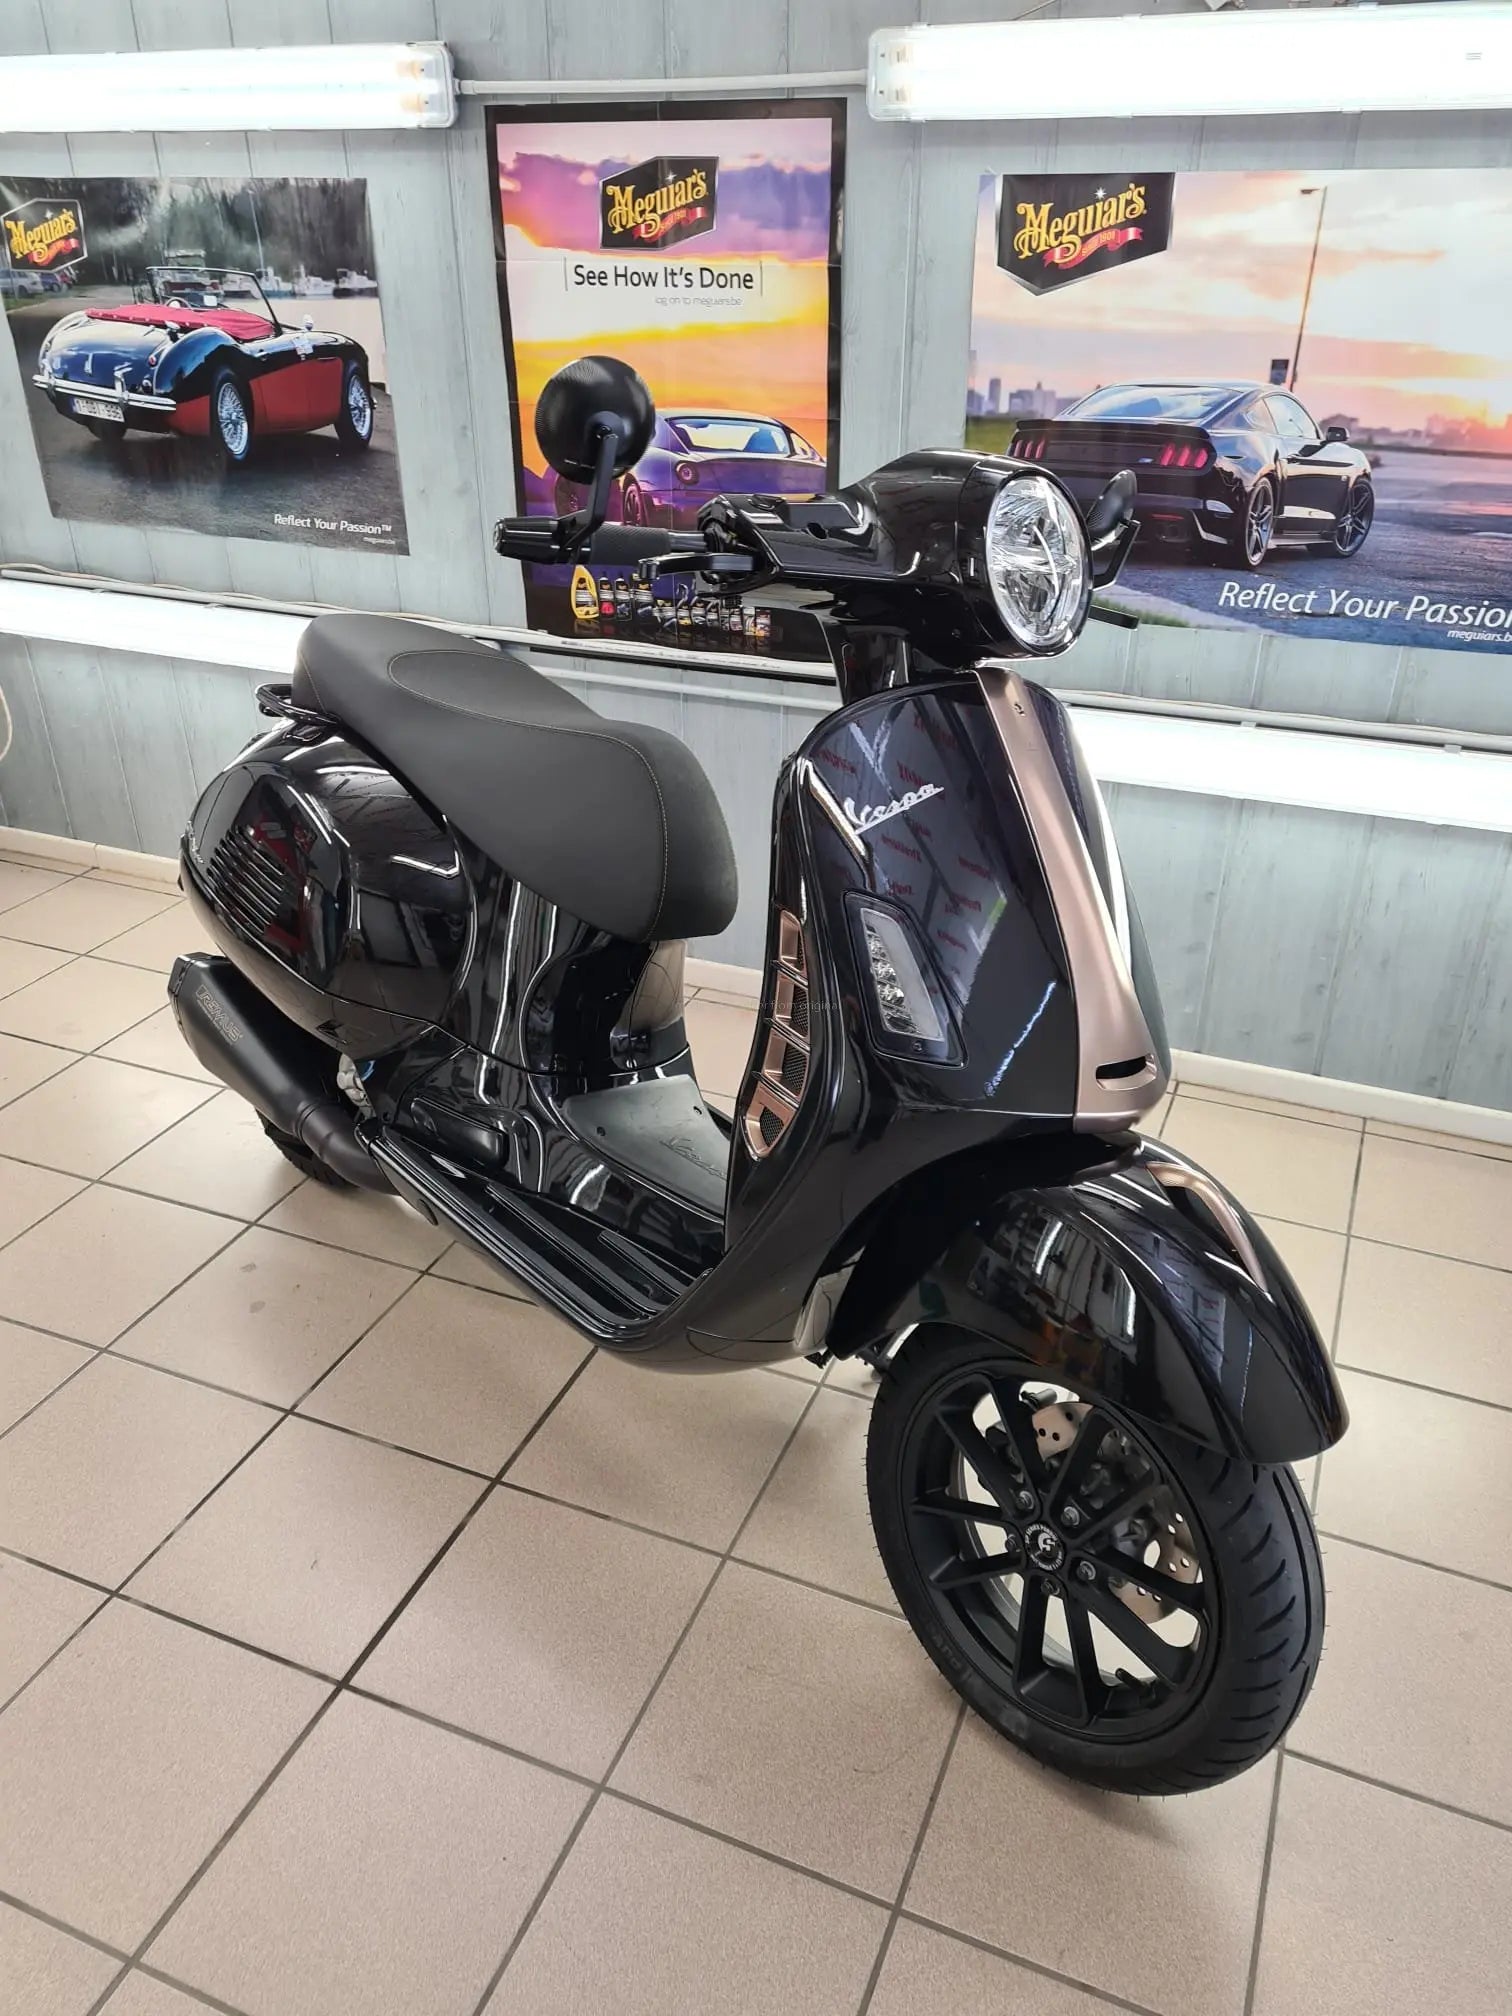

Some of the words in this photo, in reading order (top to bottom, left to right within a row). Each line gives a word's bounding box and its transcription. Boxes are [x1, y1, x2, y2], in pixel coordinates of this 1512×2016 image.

[606, 168, 707, 238] Meguiar's
[1014, 182, 1147, 264] Meguiar's
[5, 208, 77, 262] Meguiar's
[574, 264, 608, 286] See
[614, 265, 658, 288] How
[664, 266, 694, 288] It's
[700, 267, 754, 290] Done
[274, 513, 311, 527] Reflect
[314, 518, 338, 530] Your
[1218, 581, 1318, 614] Reflect
[1328, 589, 1401, 620] Your
[843, 783, 944, 835] Vespa
